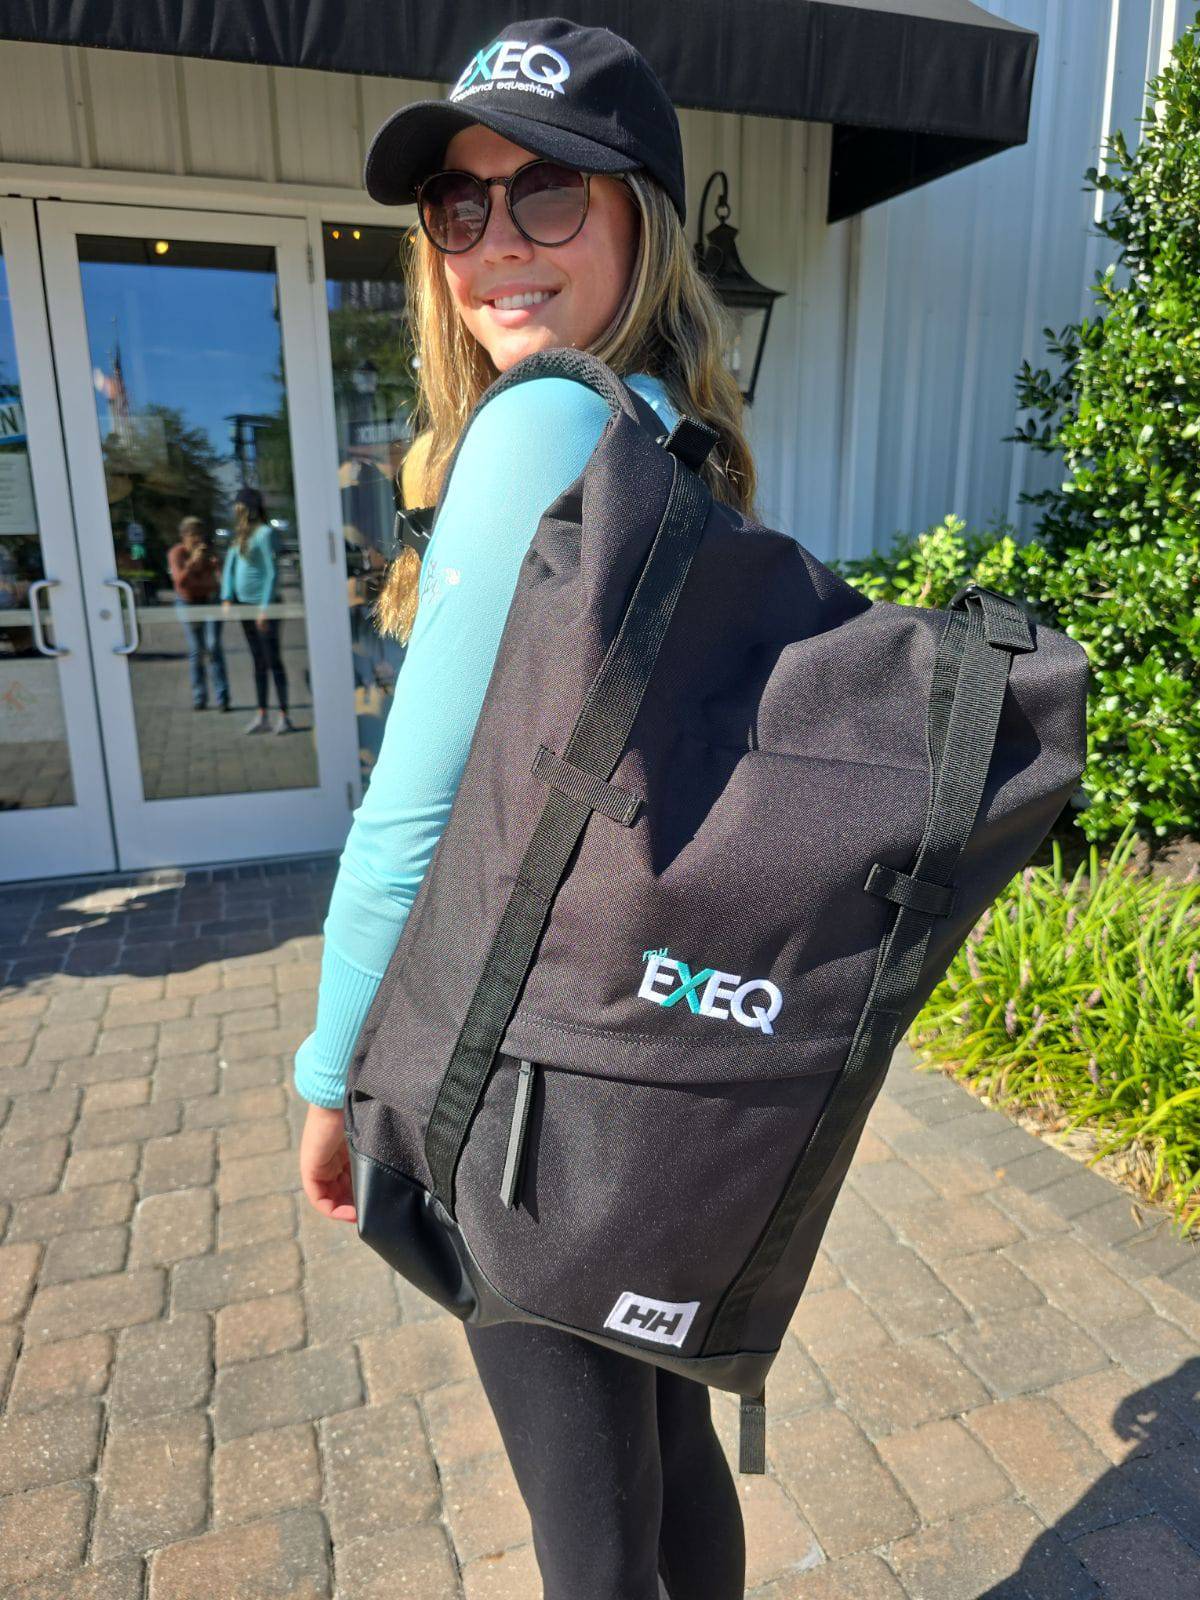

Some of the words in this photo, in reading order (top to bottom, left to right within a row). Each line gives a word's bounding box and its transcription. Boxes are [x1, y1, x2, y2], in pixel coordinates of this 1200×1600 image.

[496, 81, 555, 99] equestrian
[638, 955, 783, 1035] EXEQ
[621, 1304, 683, 1335] HH
